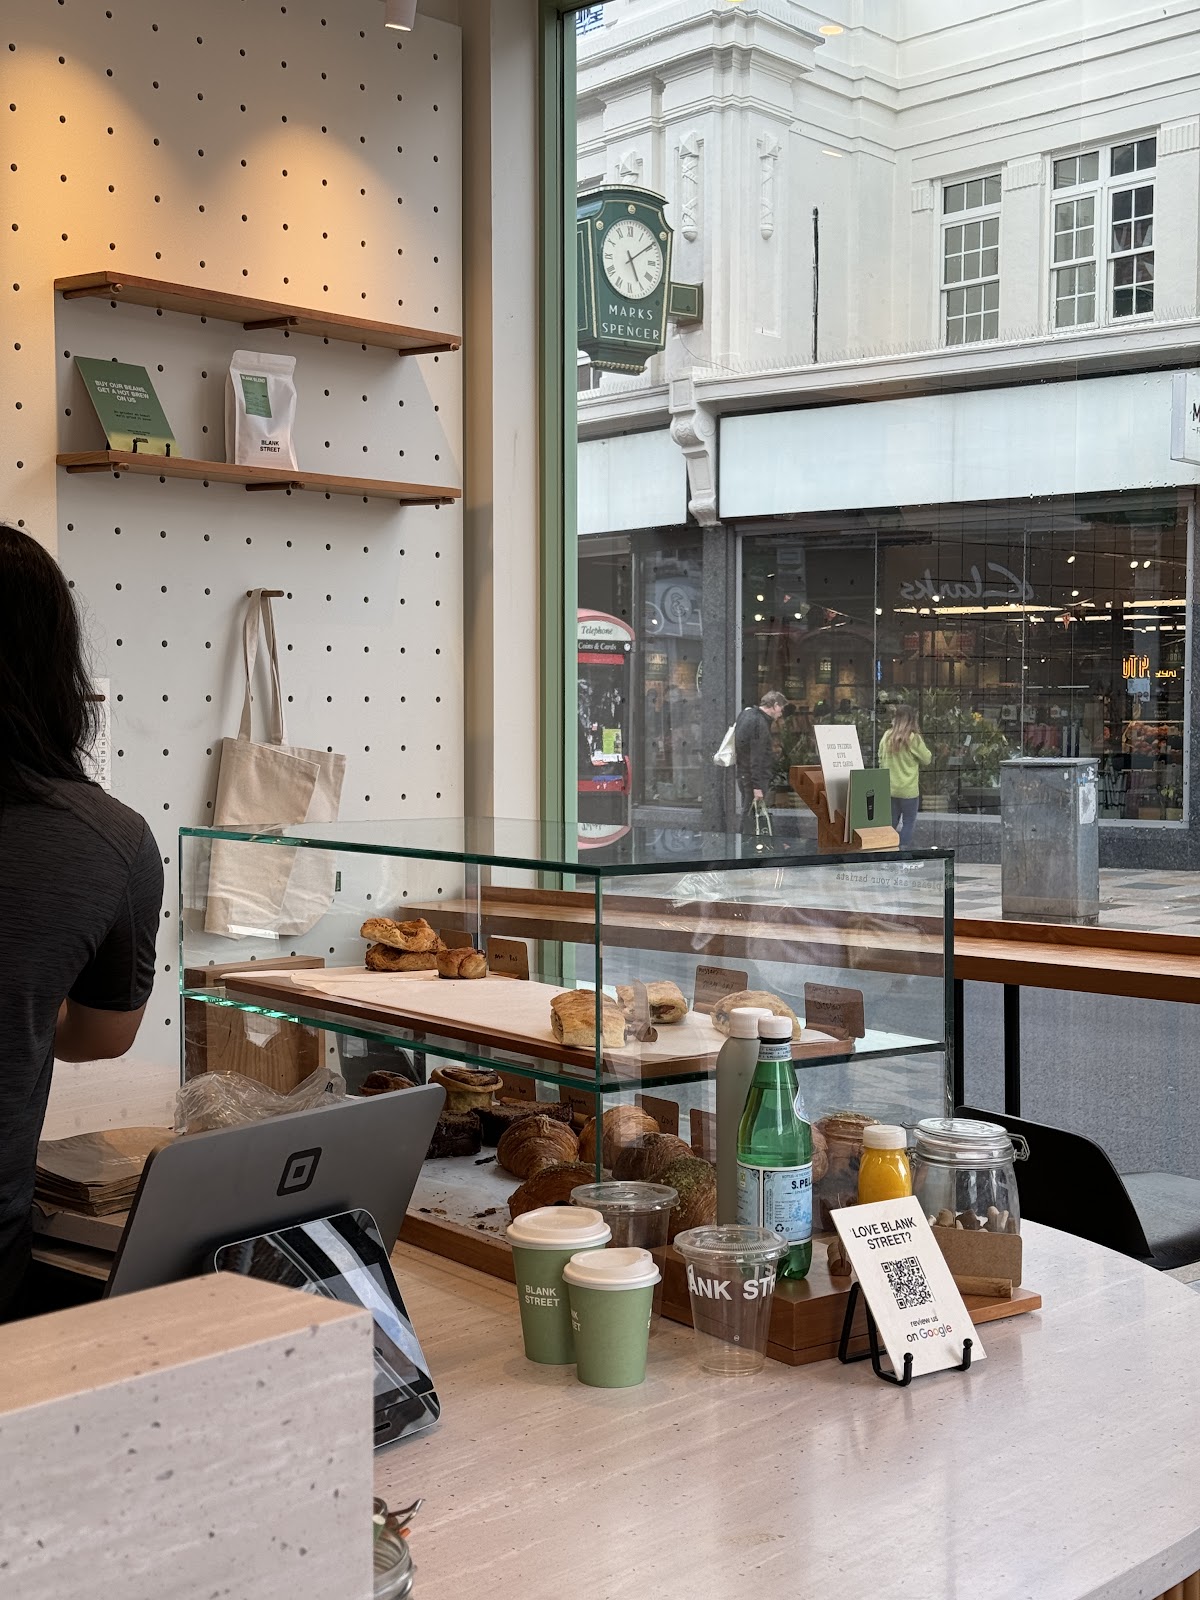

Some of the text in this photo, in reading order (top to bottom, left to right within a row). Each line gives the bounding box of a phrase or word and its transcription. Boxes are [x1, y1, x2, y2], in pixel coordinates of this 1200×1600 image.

[608, 304, 653, 320] MARKS
[602, 322, 659, 340] SPENCER
[117, 389, 130, 397] HOT
[131, 391, 149, 399] BREW
[581, 626, 614, 636] Telephone
[578, 642, 593, 650] Coins
[851, 1217, 917, 1238] LOVE BLANK
[867, 1231, 912, 1250] STREET?
[525, 1284, 556, 1296] BLANK
[525, 1295, 559, 1307] STREET
[910, 1315, 939, 1327] review us
[906, 1323, 952, 1342] on Google
